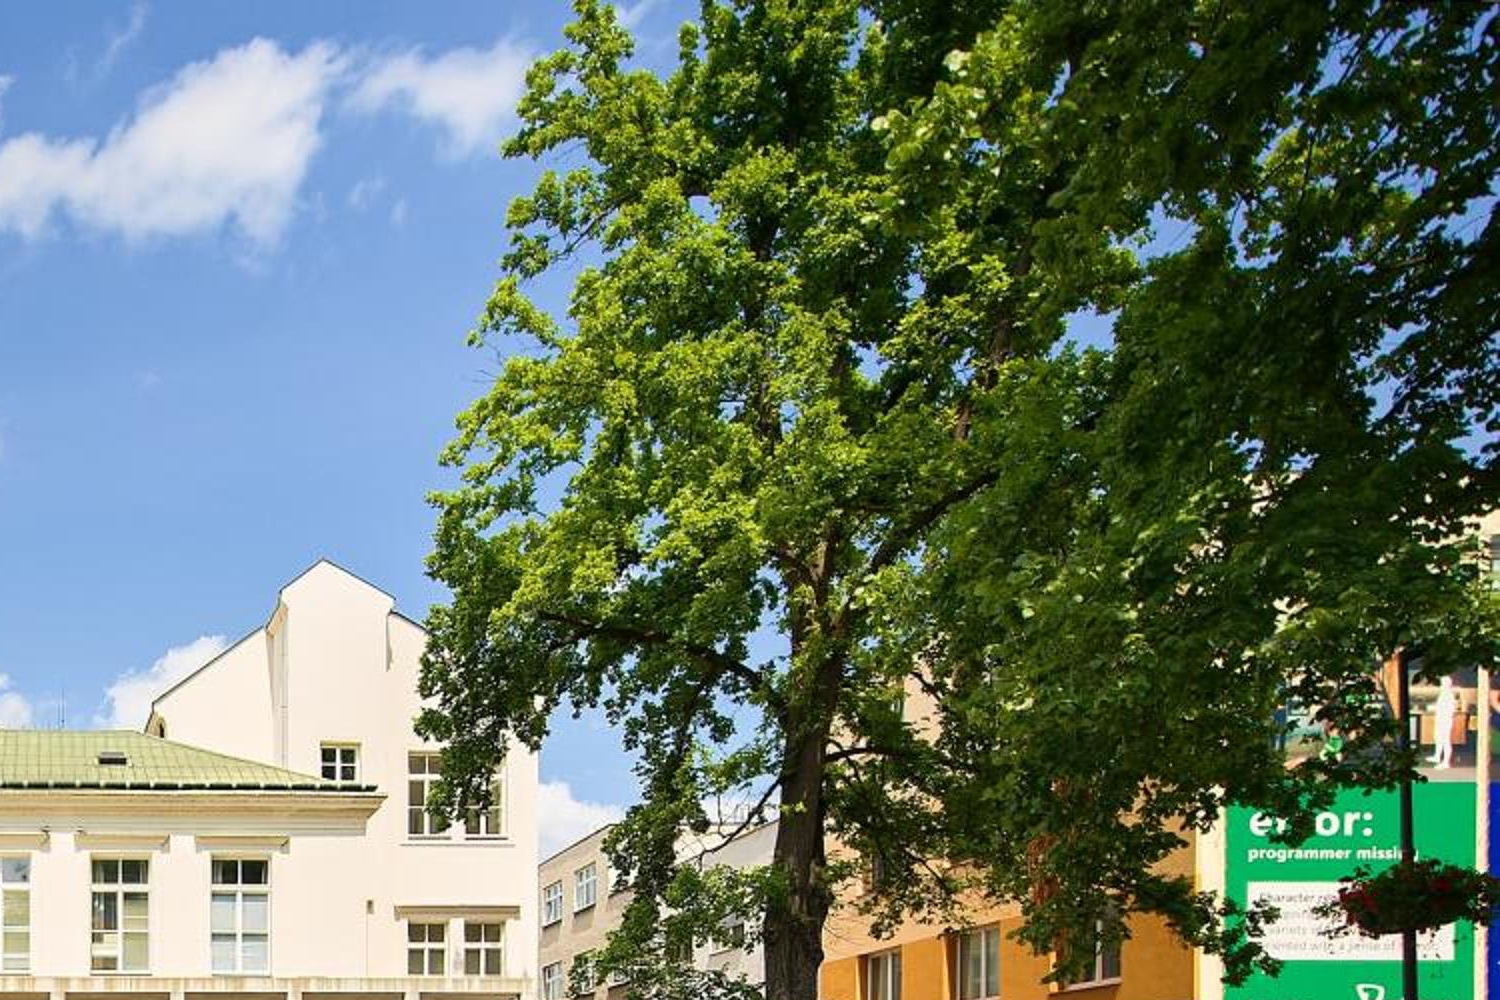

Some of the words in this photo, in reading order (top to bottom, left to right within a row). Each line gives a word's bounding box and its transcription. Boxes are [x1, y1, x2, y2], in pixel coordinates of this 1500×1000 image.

[1249, 811, 1373, 837] eror:
[1247, 847, 1352, 863] programmer
[1356, 846, 1419, 863] missi
